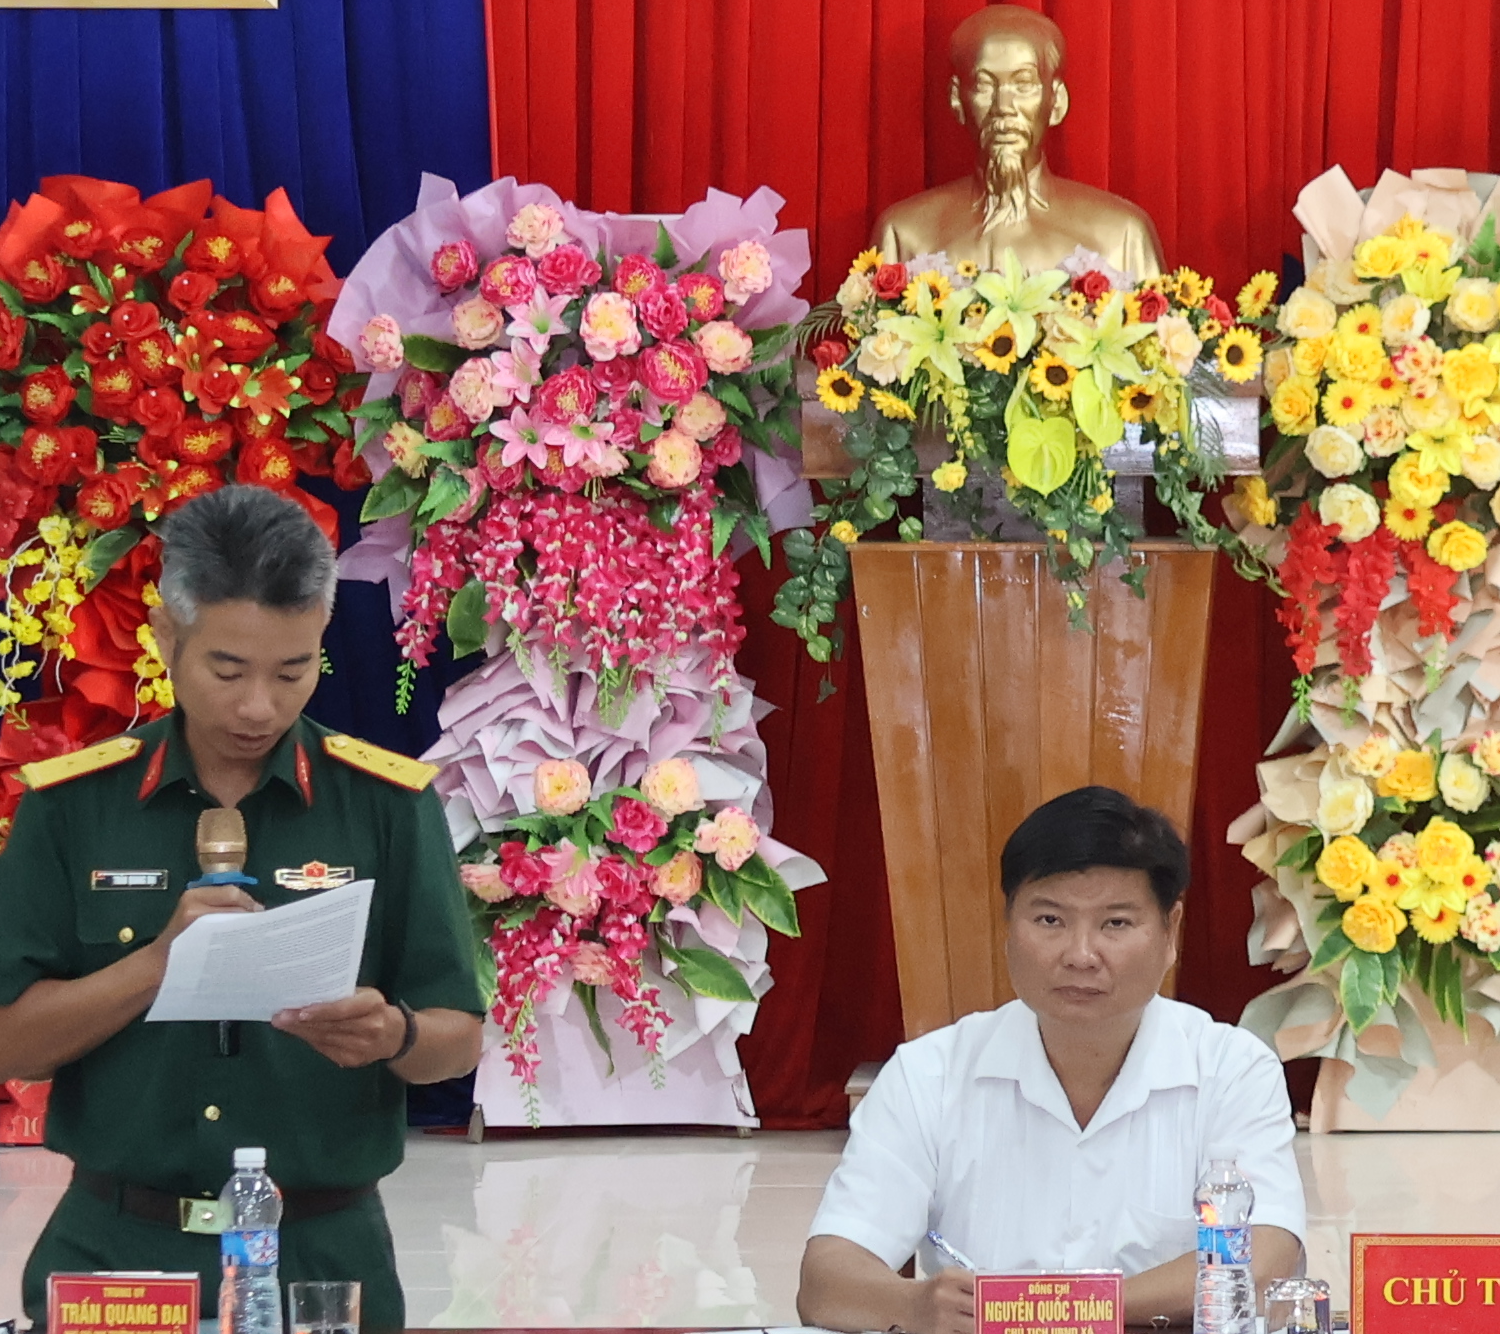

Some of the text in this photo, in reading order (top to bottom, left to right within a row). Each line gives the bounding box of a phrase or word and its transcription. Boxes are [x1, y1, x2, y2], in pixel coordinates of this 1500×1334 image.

[1382, 1268, 1468, 1307] CHỦ
[104, 1302, 159, 1327] QUANG
[1037, 1293, 1070, 1324] QUỐC
